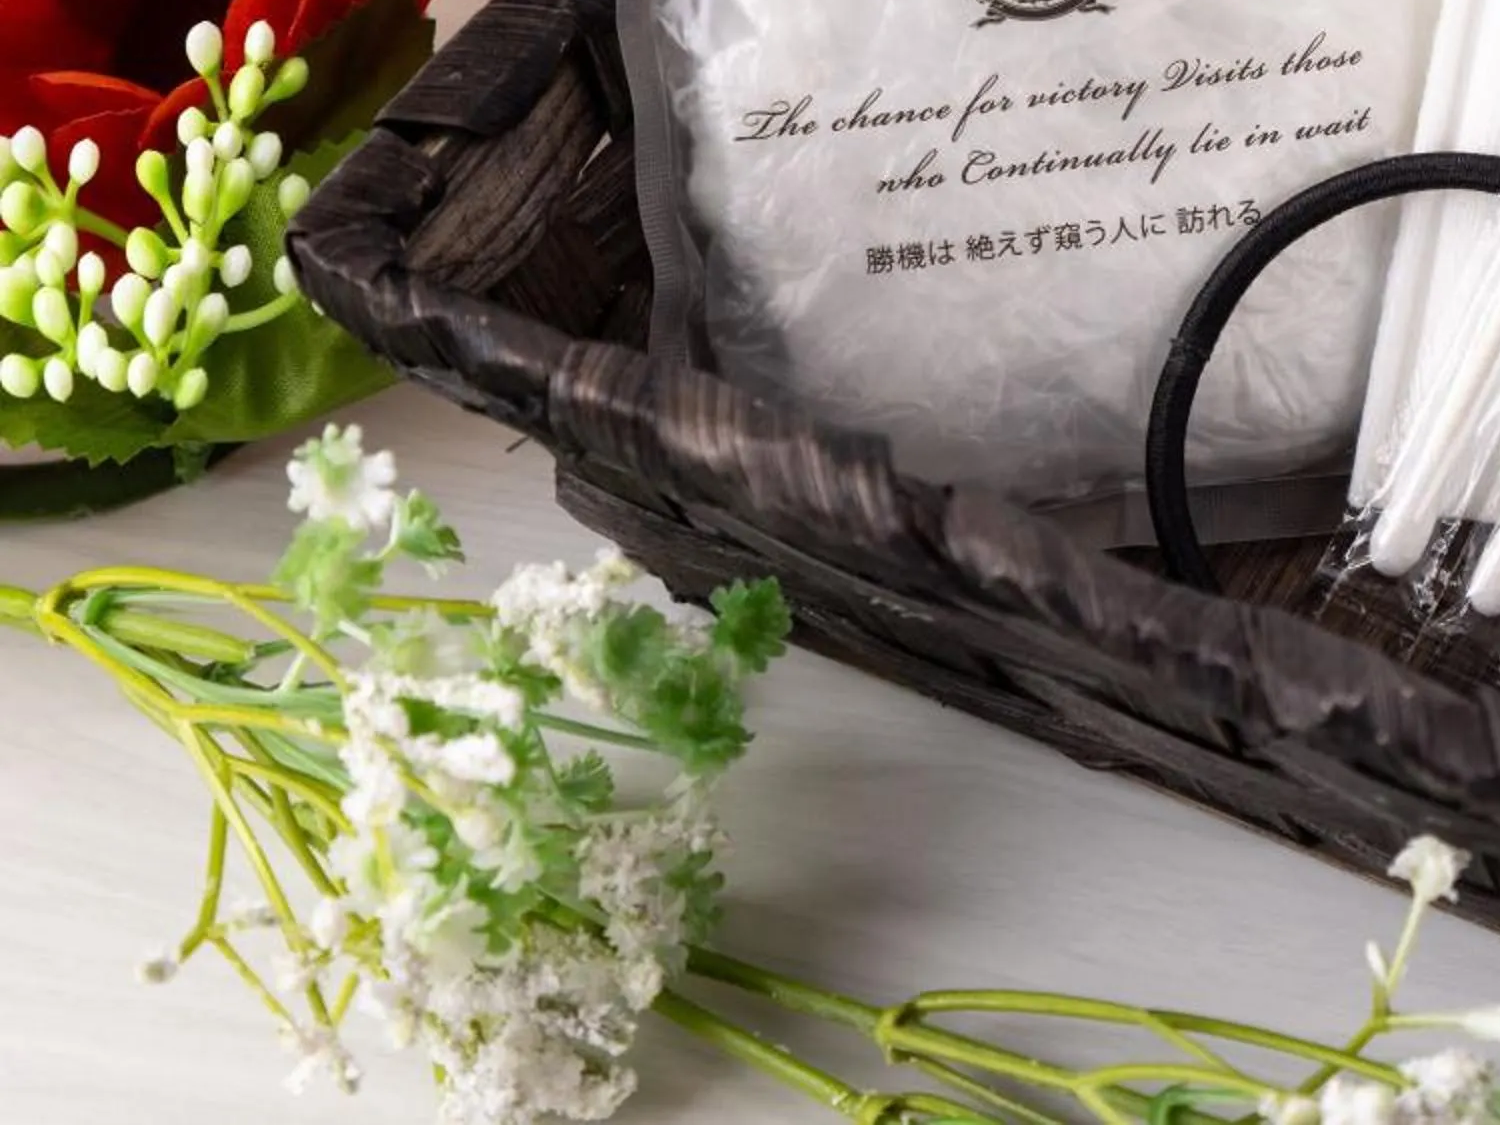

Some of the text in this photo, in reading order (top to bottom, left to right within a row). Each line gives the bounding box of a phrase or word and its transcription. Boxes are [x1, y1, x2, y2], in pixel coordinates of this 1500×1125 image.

[735, 33, 1361, 142] The chance for victory Visits those
[877, 107, 1370, 193] who Continually lie in wait
[867, 200, 1262, 274] 勝機は 絶えず窺う人に 訪れる
